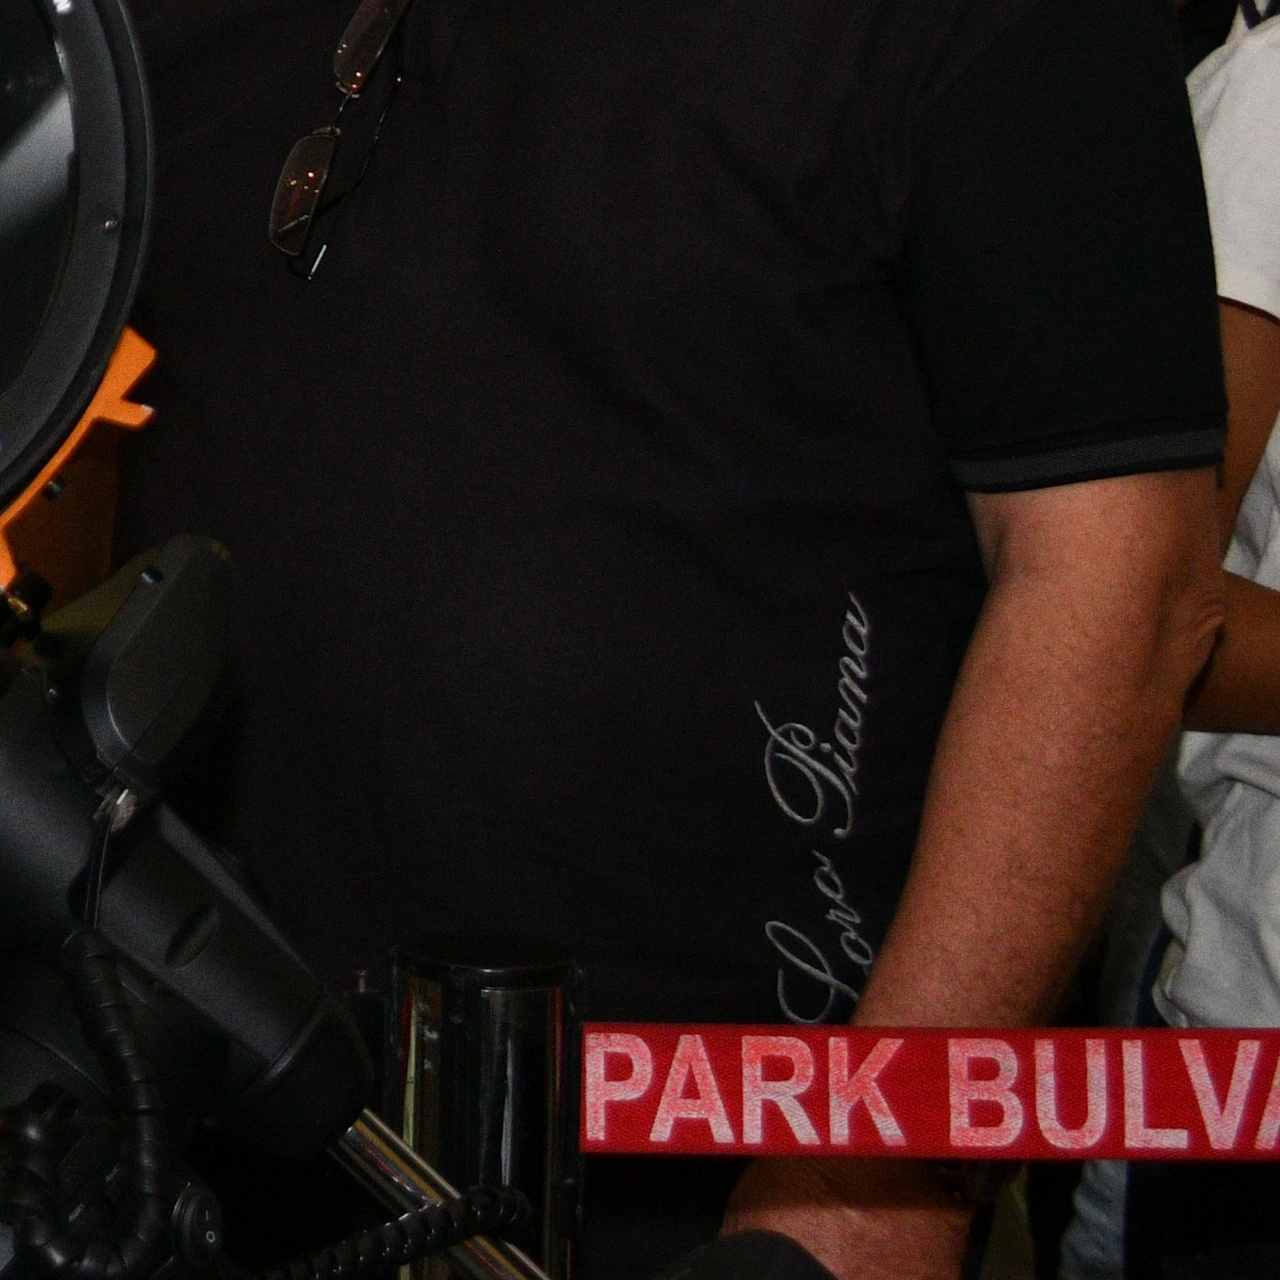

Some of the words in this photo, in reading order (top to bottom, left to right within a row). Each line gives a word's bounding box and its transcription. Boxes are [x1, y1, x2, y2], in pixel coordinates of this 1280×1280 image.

[754, 591, 869, 839] Piana
[585, 1032, 907, 1147] PARK
[948, 1038, 1280, 1150] BULV
